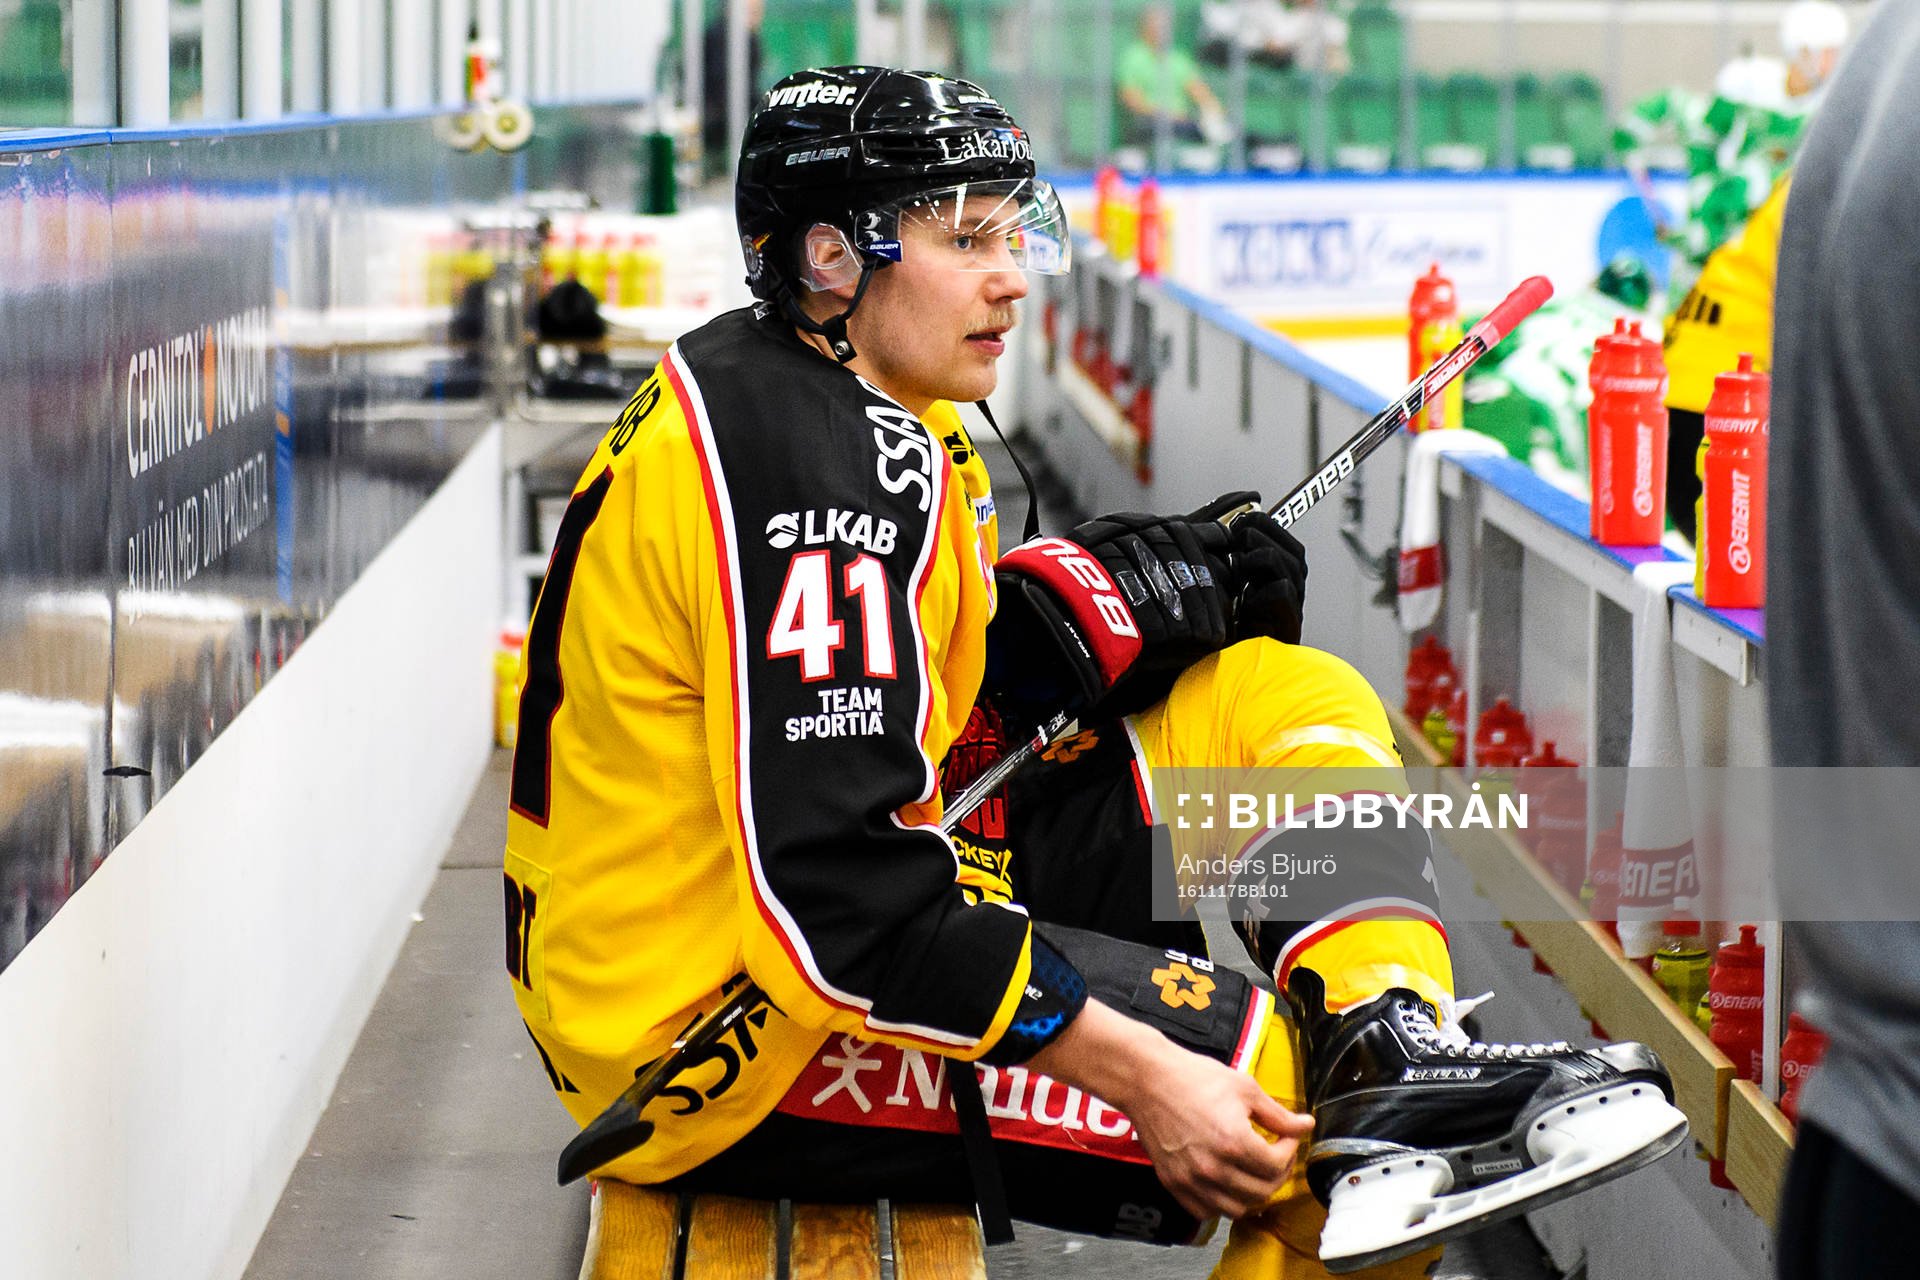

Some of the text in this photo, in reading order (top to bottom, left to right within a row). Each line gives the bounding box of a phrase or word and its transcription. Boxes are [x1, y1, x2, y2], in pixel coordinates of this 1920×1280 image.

[785, 146, 851, 166] BAUER
[127, 328, 202, 479] CERNITOL
[1271, 448, 1354, 530] BAUER
[177, 496, 199, 588] MED
[204, 477, 222, 567] DIN
[804, 508, 898, 555] LKAB
[766, 549, 897, 683] 41
[785, 711, 884, 742] SPORTIA
[818, 687, 883, 713] TEAM
